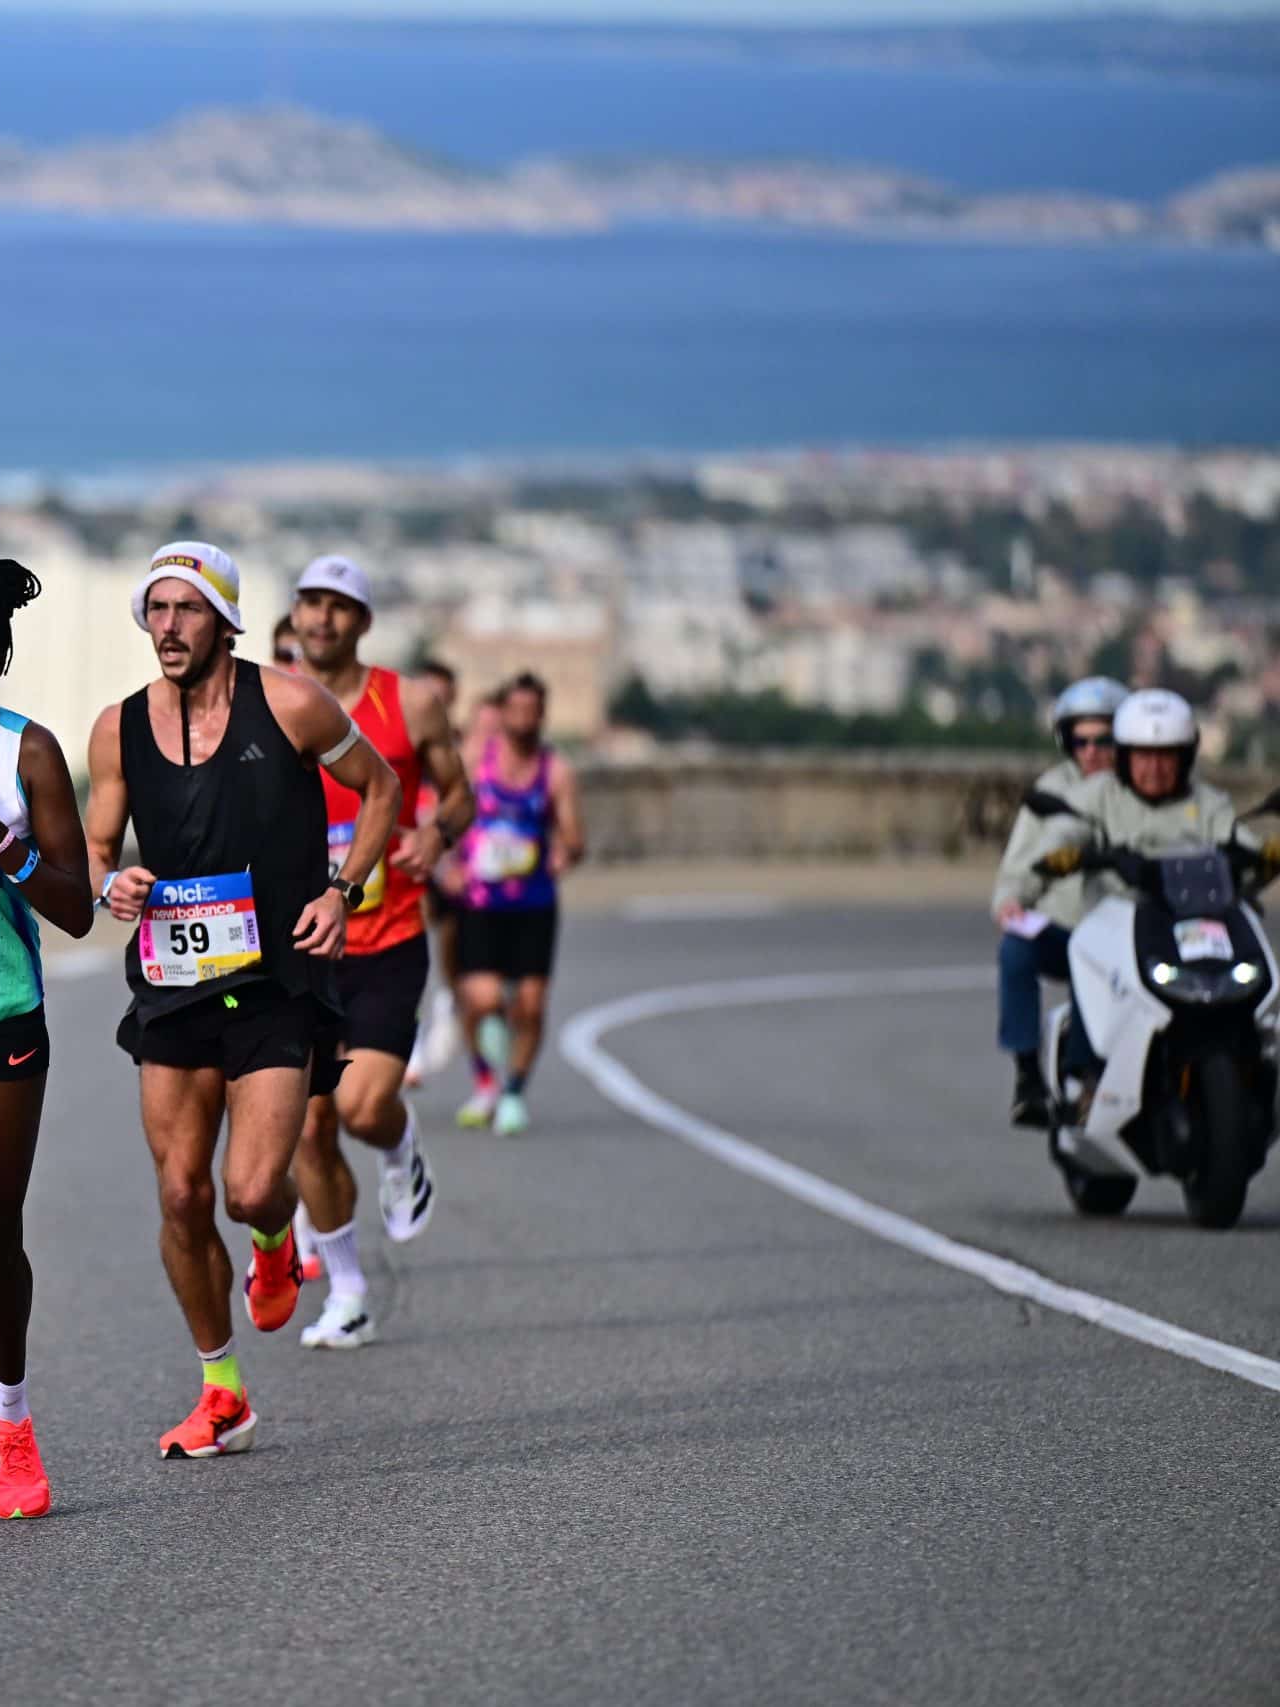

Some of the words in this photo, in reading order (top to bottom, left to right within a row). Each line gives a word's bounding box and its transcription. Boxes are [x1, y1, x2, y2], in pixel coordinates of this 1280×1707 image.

[152, 909, 177, 920] new
[177, 903, 235, 919] balance
[169, 922, 210, 955] 59
